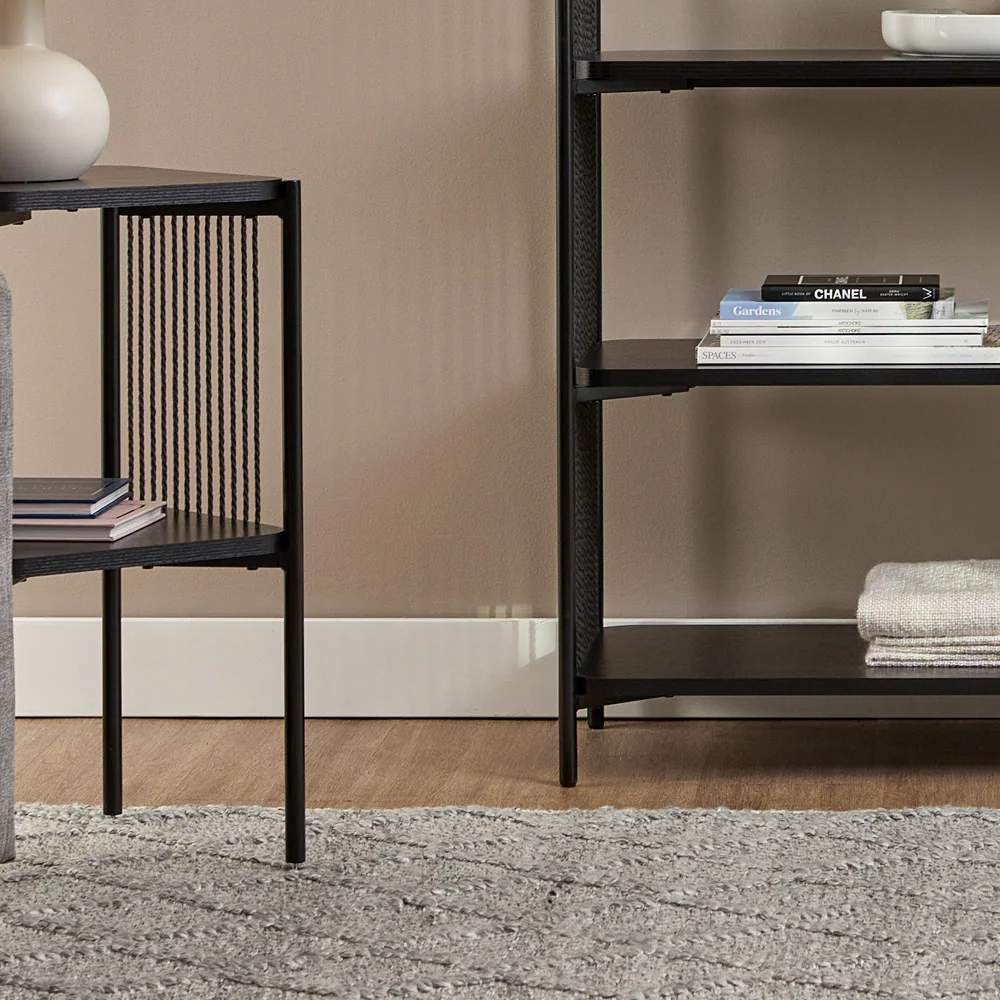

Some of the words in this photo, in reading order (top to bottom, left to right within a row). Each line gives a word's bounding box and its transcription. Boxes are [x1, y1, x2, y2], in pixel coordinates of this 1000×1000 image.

[814, 288, 867, 299] CHANEL
[733, 306, 782, 316] Gardens
[702, 352, 736, 360] SPACES
